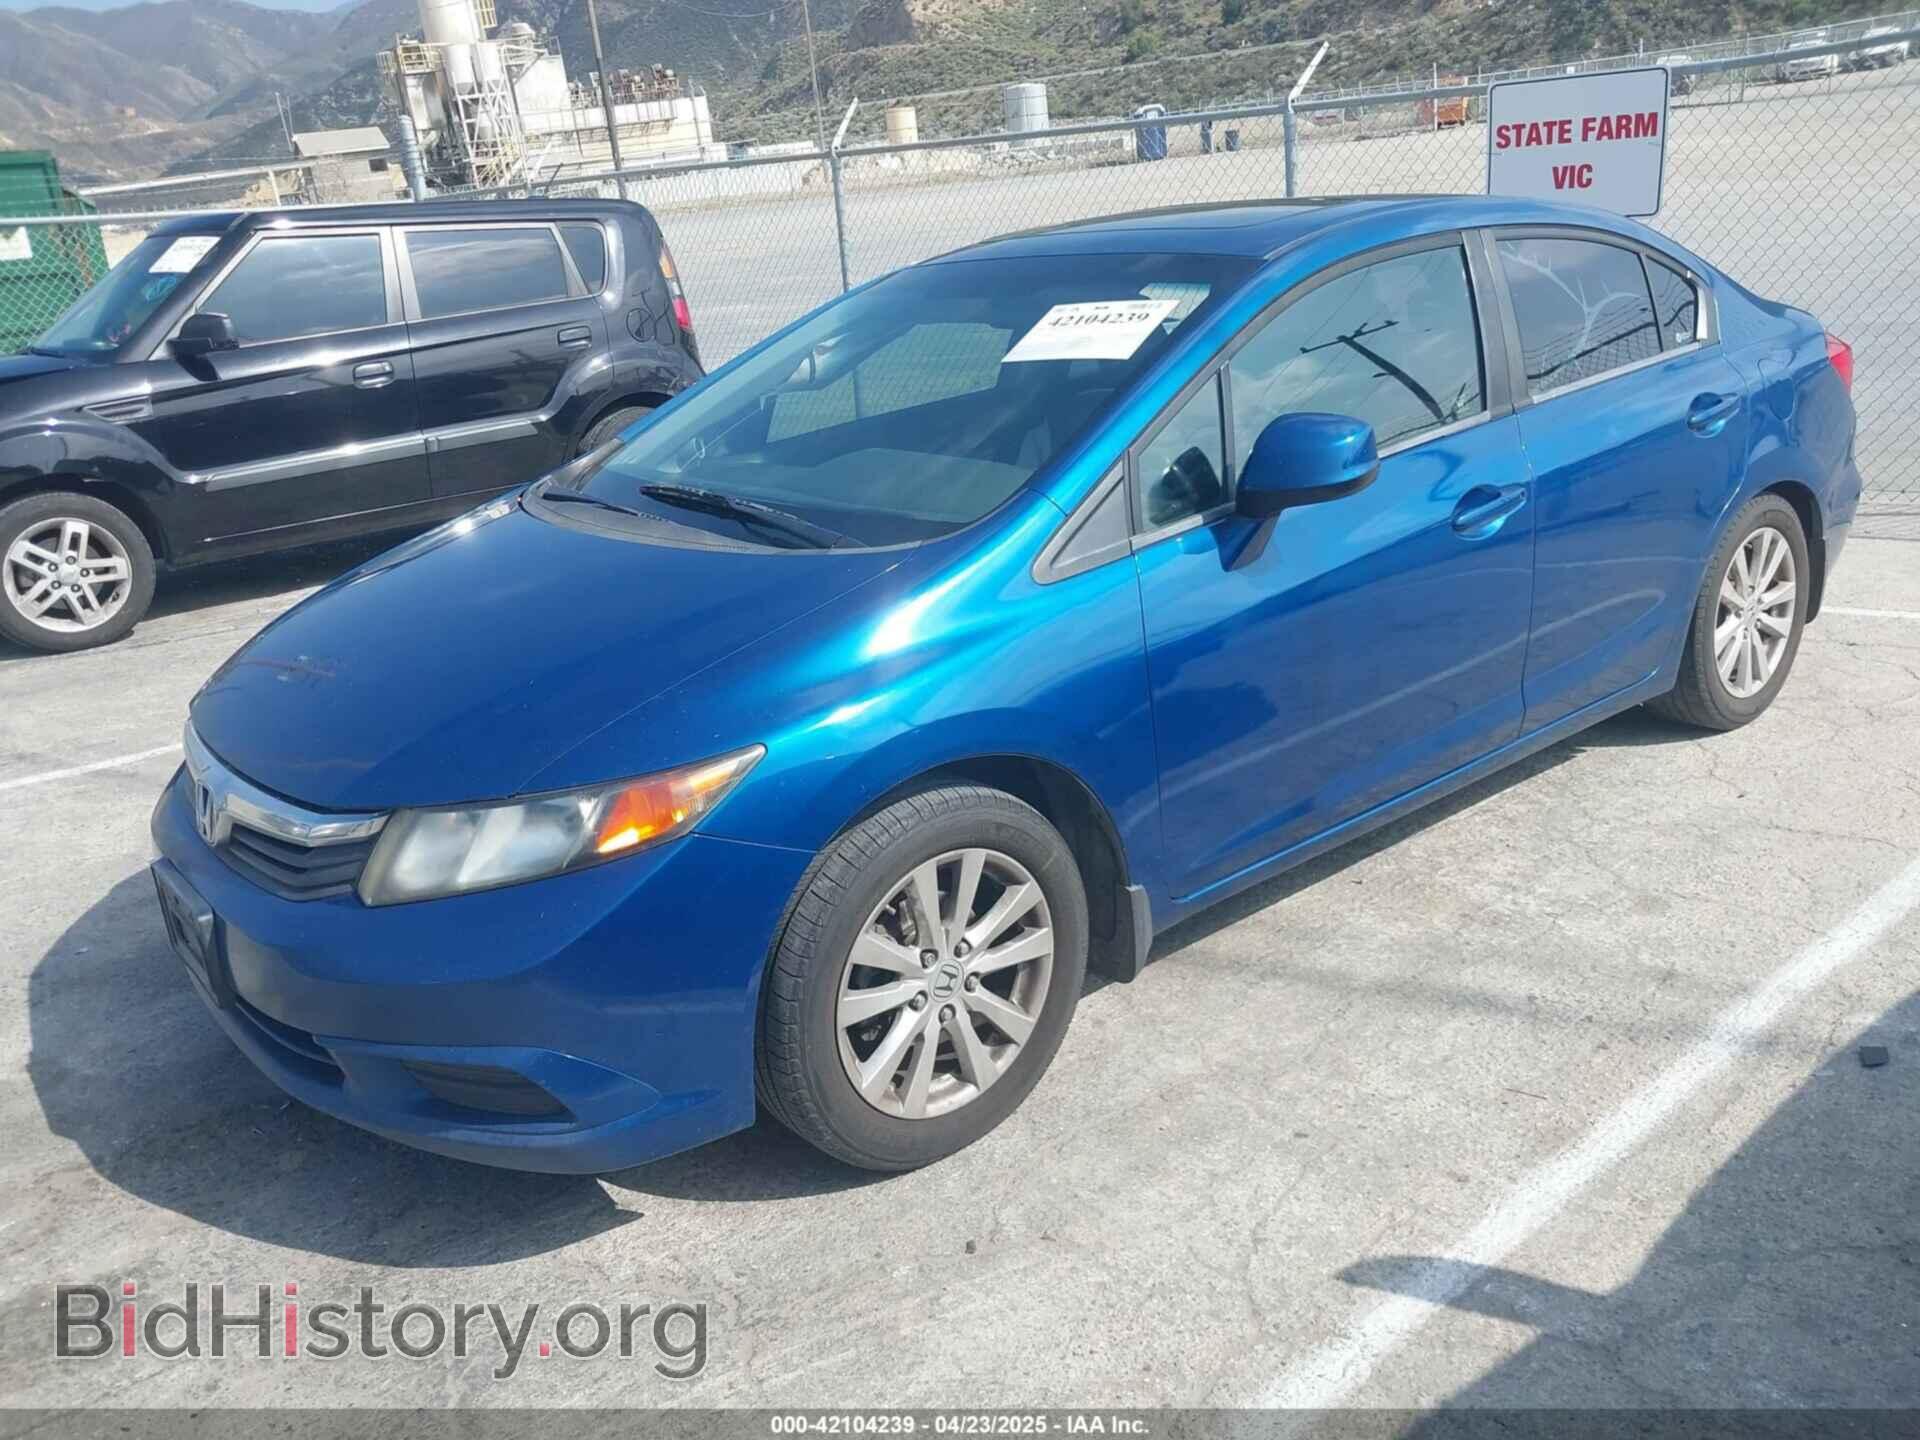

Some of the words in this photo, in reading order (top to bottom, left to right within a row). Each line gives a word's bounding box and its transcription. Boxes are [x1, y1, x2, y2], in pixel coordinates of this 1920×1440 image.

[1495, 119, 1573, 149] STATE
[1581, 112, 1659, 142] FARM
[1552, 163, 1594, 190] VIC
